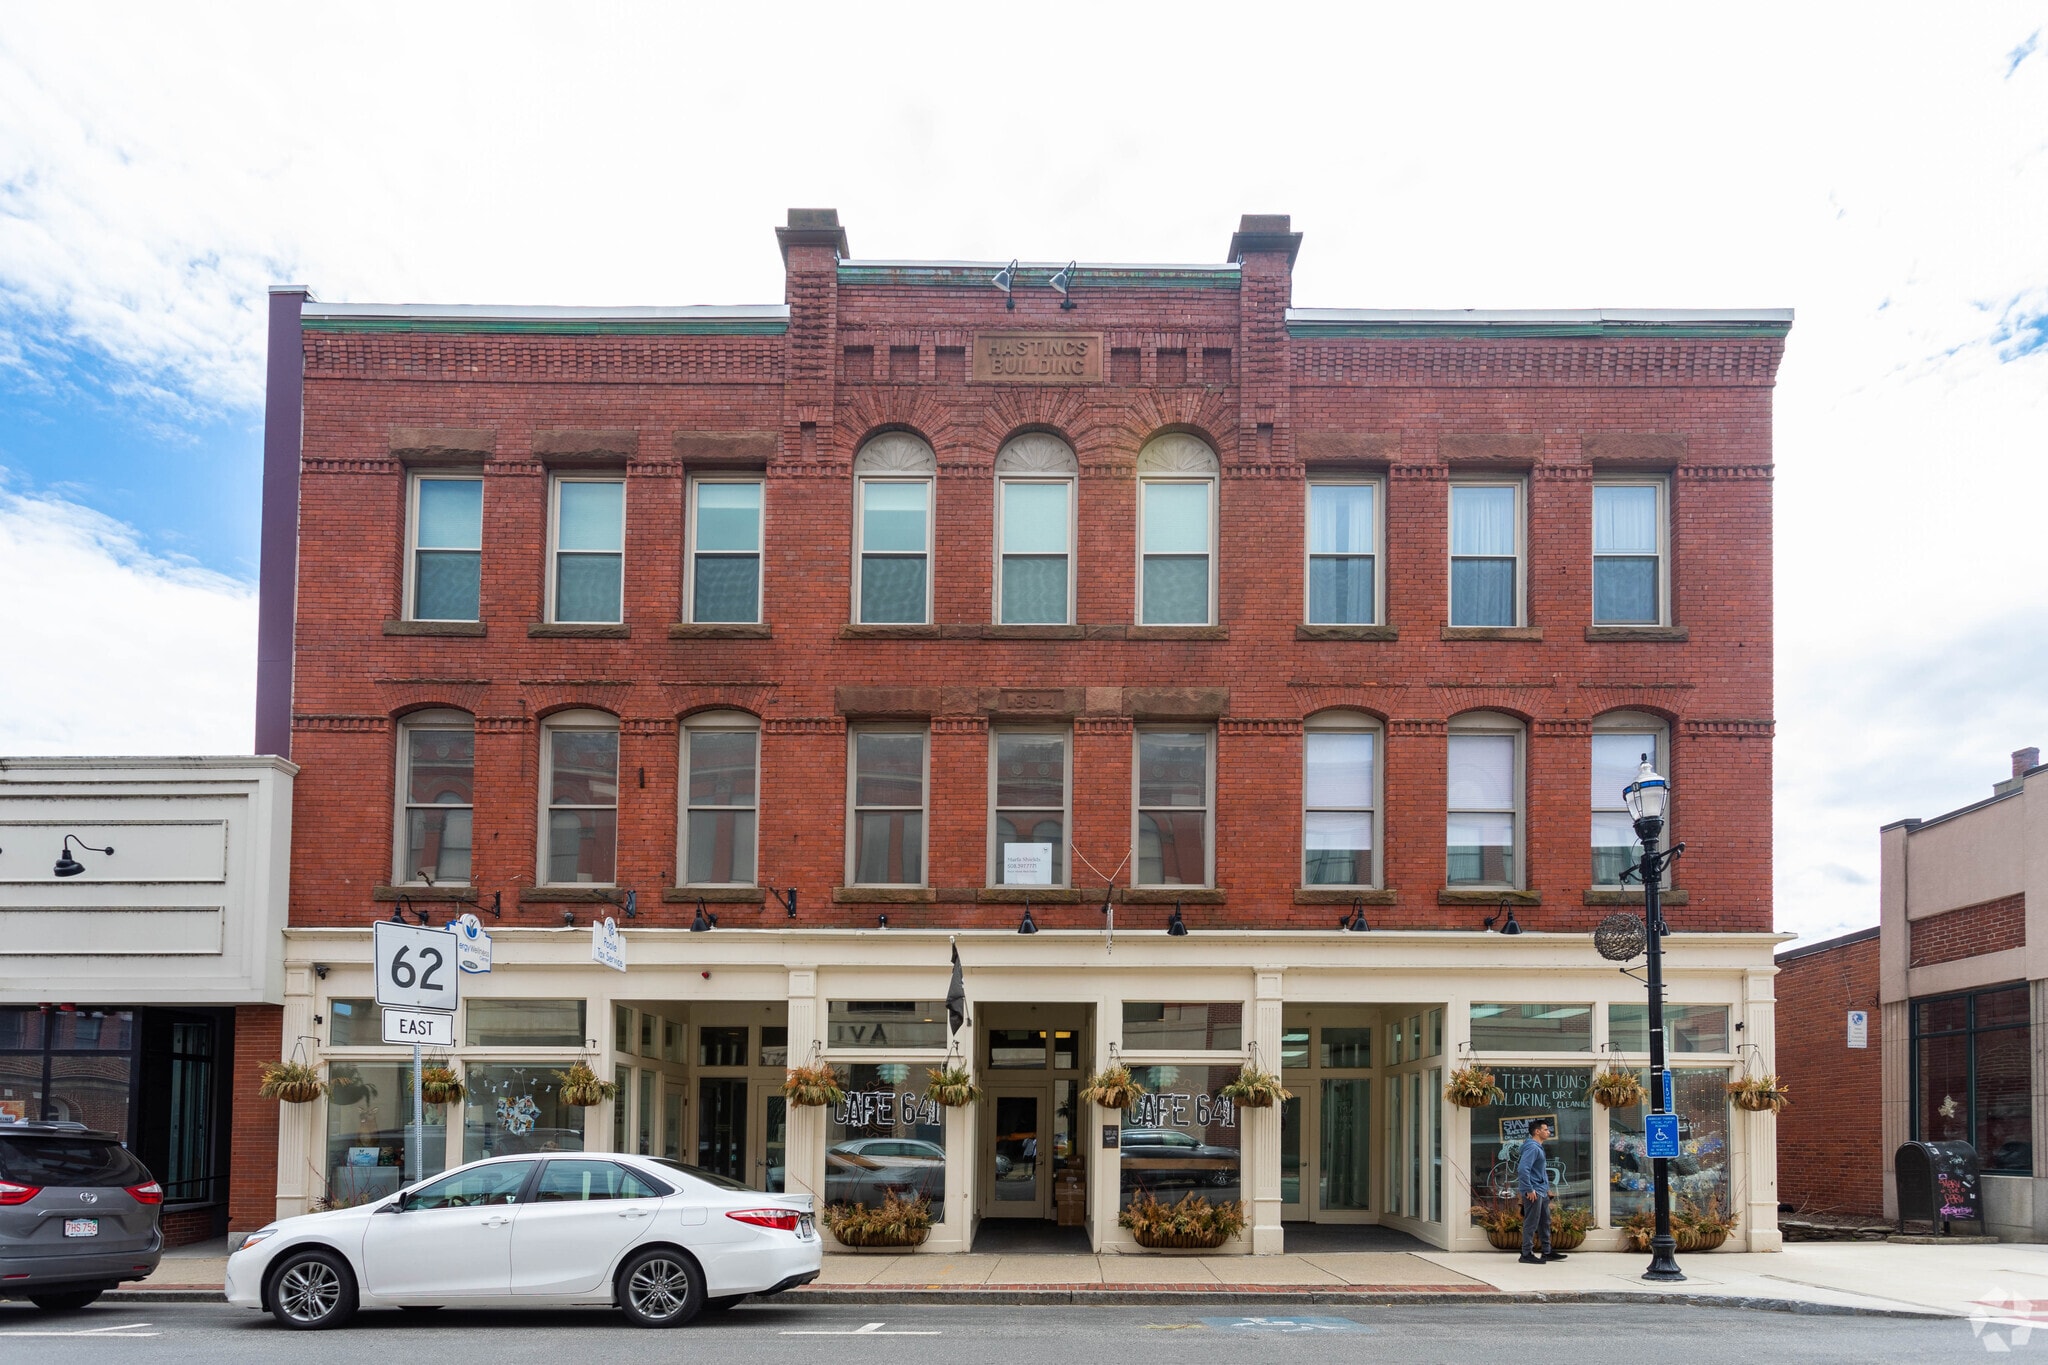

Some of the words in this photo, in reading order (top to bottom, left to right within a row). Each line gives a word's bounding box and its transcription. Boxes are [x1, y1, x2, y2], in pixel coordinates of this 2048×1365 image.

[988, 341, 1089, 357] HASTINGS
[991, 360, 1085, 376] BUILDING
[1007, 694, 1056, 710] 1894
[391, 945, 444, 991] 62
[400, 1018, 434, 1036] EAST
[1492, 1073, 1588, 1089] TERATIONS
[1552, 1090, 1573, 1099] DRY
[833, 1090, 896, 1127] CAFE
[901, 1091, 941, 1126] 641
[1128, 1092, 1190, 1128] CAFE
[1195, 1093, 1236, 1128] 641
